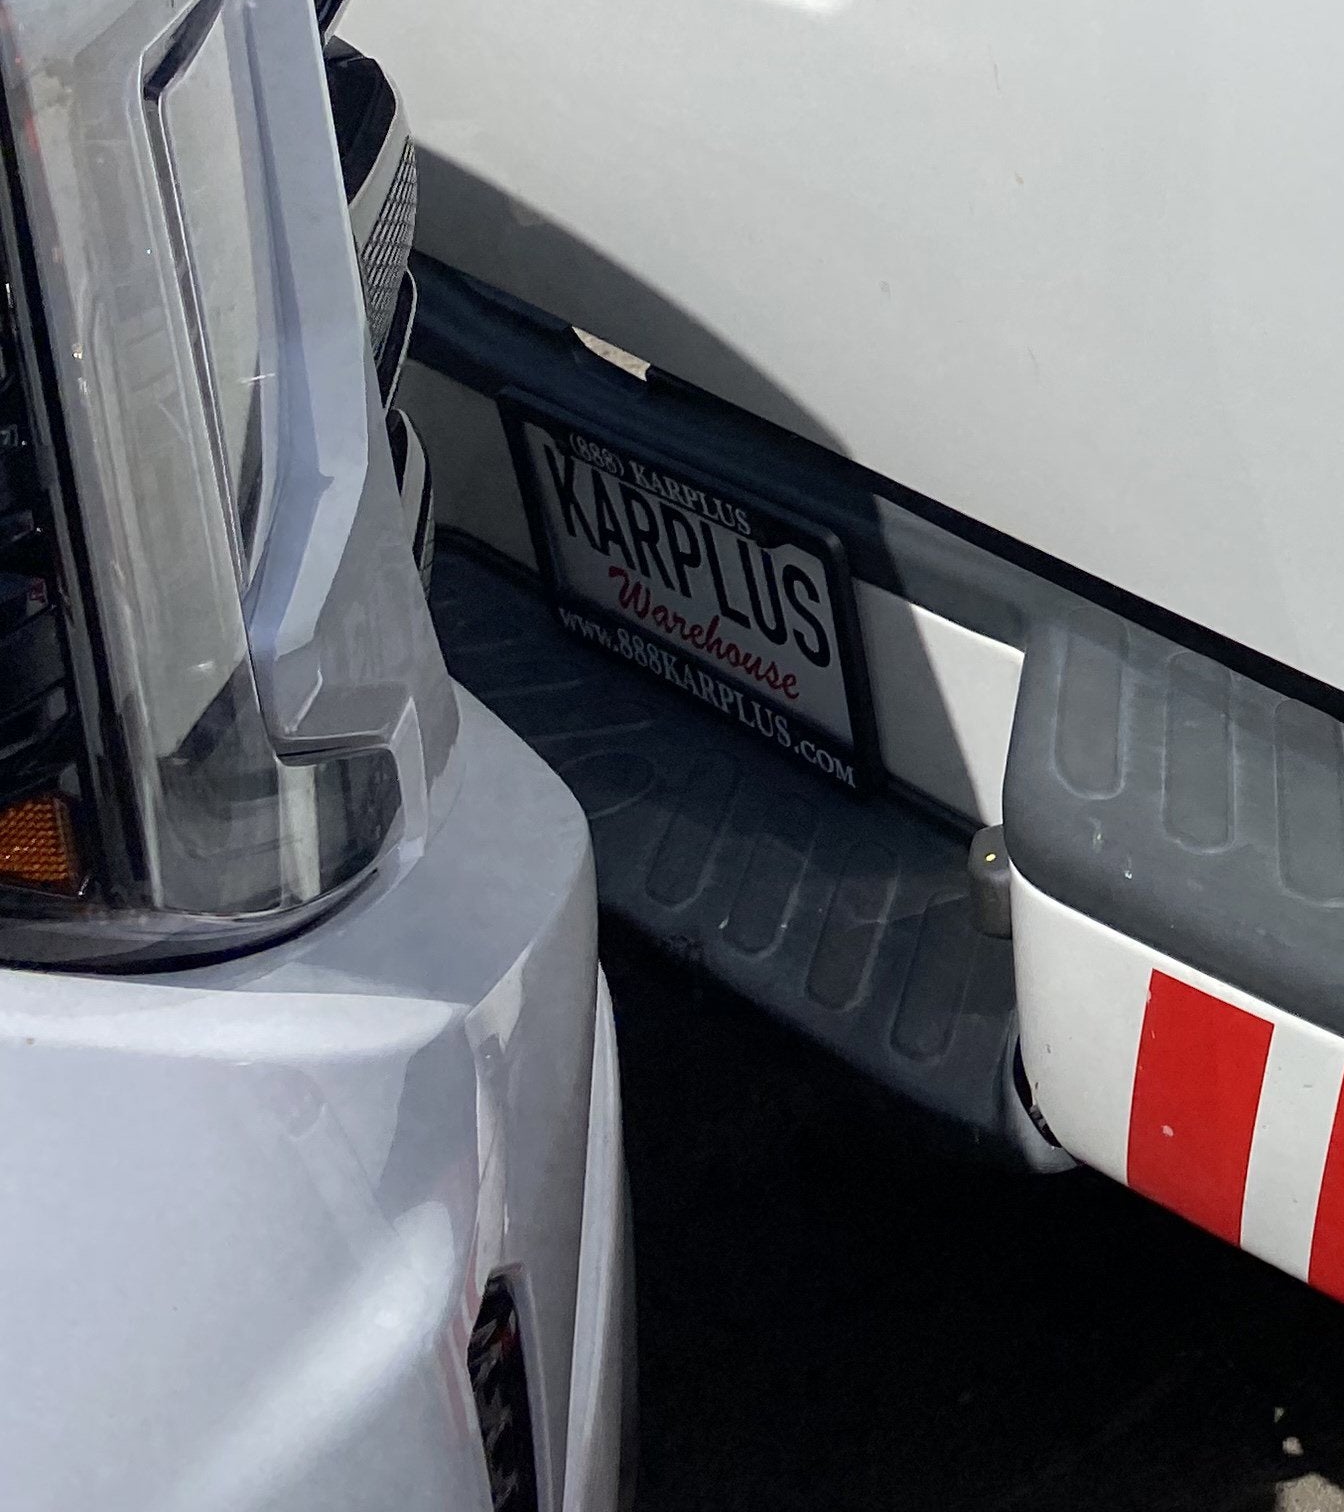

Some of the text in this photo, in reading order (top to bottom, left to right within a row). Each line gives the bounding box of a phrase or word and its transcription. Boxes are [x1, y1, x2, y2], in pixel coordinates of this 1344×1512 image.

[570, 433, 752, 535] (888) KARPLUS
[544, 444, 831, 669] KARPLUS
[608, 565, 800, 700] Warehouse
